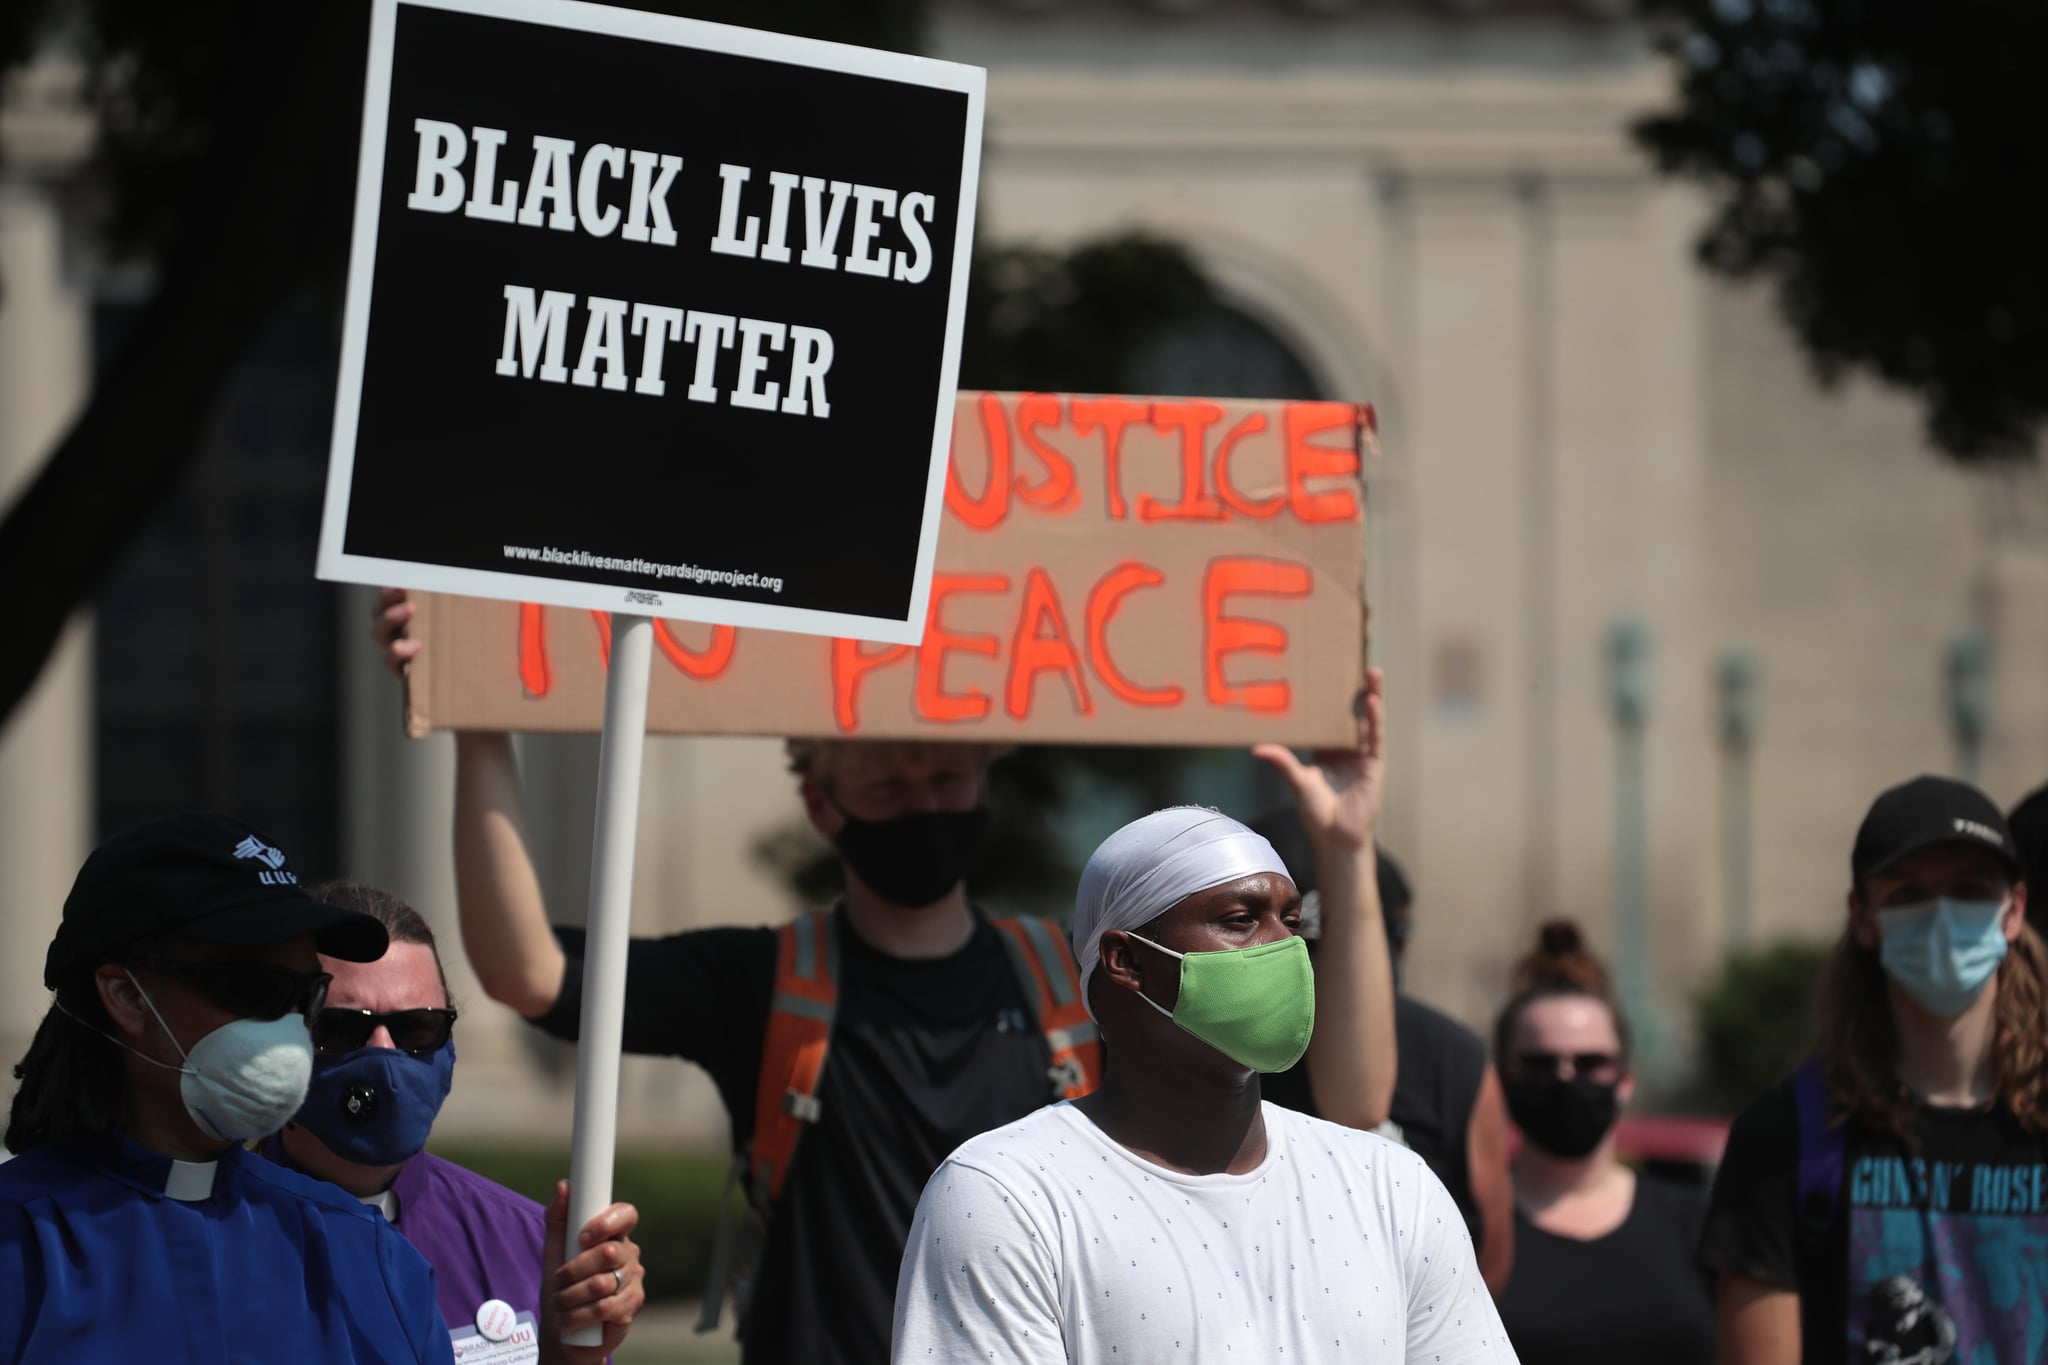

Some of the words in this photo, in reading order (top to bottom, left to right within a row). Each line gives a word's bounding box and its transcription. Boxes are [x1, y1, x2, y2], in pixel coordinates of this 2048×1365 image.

[407, 118, 683, 247] BLACK
[710, 163, 936, 284] LIVES
[495, 284, 835, 419] MATTER
[943, 391, 1361, 533] USTICE
[503, 545, 784, 593] www.blacklivesmatteryardsignproject.org
[1971, 1163, 2048, 1214] ROSE
